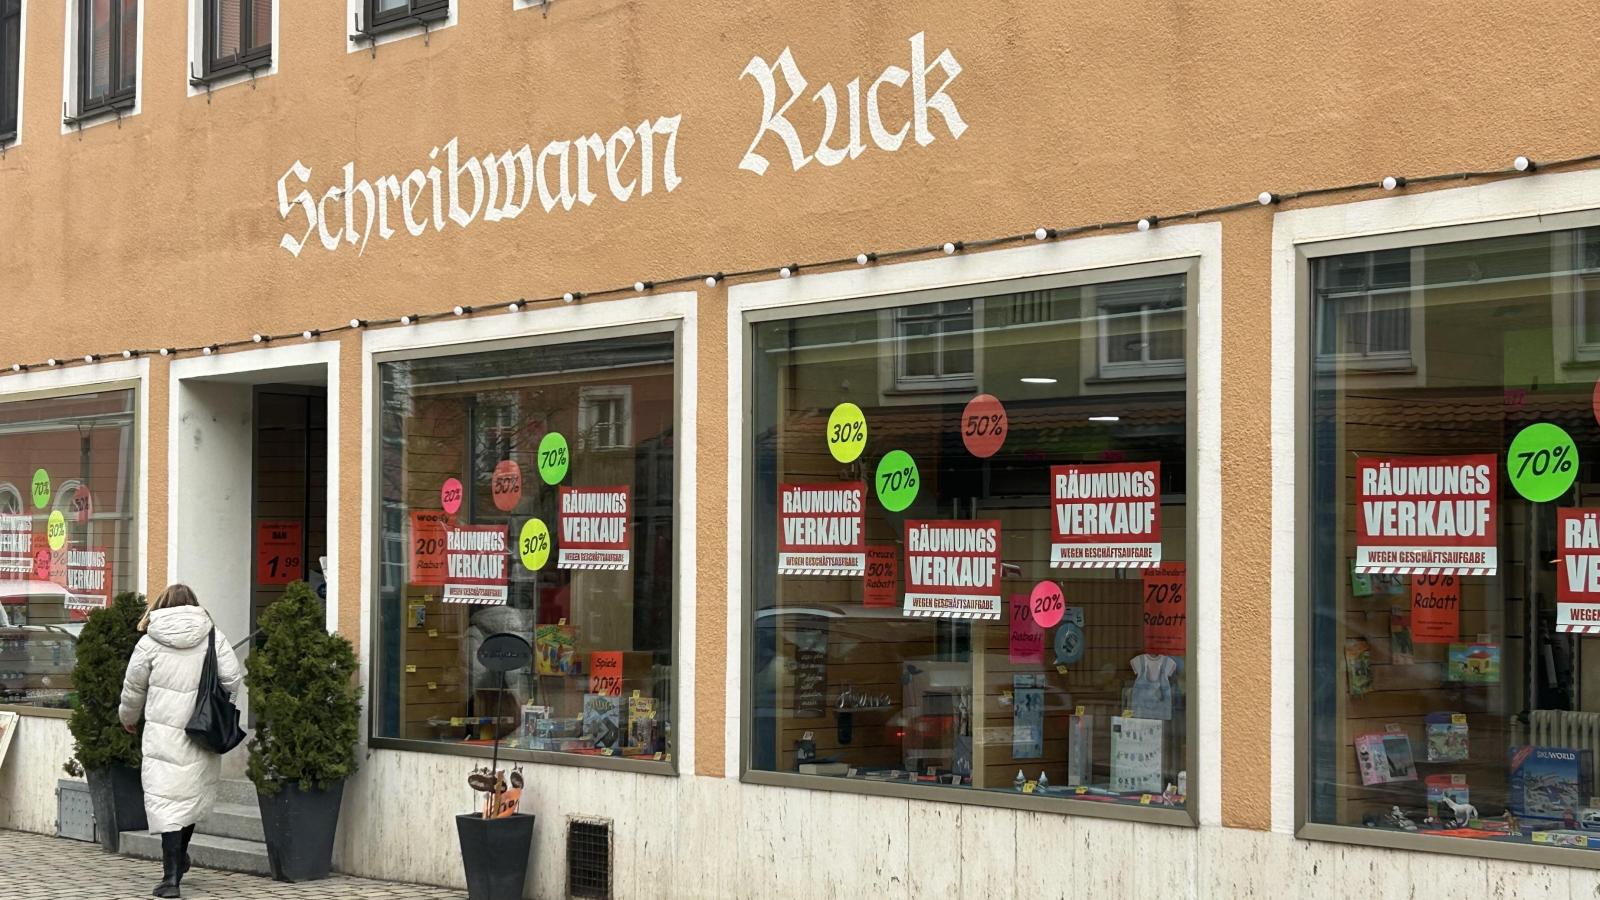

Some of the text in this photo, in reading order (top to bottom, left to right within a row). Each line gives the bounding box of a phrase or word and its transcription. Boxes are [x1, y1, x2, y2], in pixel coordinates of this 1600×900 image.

[279, 30, 969, 257] Schreibwaren Ruck
[830, 420, 864, 444] 30%
[965, 414, 1003, 437] 50%
[541, 446, 567, 469] 70%
[1516, 445, 1572, 479] 70%
[34, 481, 49, 496] 70%
[494, 475, 520, 494] 50%
[881, 467, 916, 494] 70%
[1055, 469, 1155, 499] RÄUMUNGS
[1362, 463, 1490, 496] RÄUMUNGS
[443, 487, 461, 502] 20%
[562, 489, 627, 513] RÄUMUNGS
[783, 487, 861, 513] RÄUMUNGS
[1056, 502, 1155, 534] VERKAUF
[1363, 500, 1490, 536] VERKAUF
[447, 528, 505, 551] RÄUMUNGS
[562, 517, 627, 543] VERKAUF
[783, 517, 861, 545] VERKAUF
[909, 524, 996, 552] RÄUMUNGS
[1565, 513, 1600, 549] RÄ
[522, 532, 547, 555] 30%
[1060, 546, 1152, 558] WEGEN GESCHÄFTSAUFGABE
[447, 554, 505, 579] VERKAUF
[1368, 550, 1486, 564] WEGEN GESCHÄFTSAUFGABE
[867, 563, 894, 577] 50%
[909, 556, 996, 587] VERKAUF
[866, 577, 895, 589] Rabatt
[1146, 583, 1182, 603] 70%
[1014, 604, 1030, 622] 70
[1034, 594, 1062, 614] 20%
[1413, 593, 1457, 610] Rabatt
[1144, 611, 1186, 627] Rabatt
[595, 657, 617, 669] Spiele
[592, 676, 621, 695] 20%
